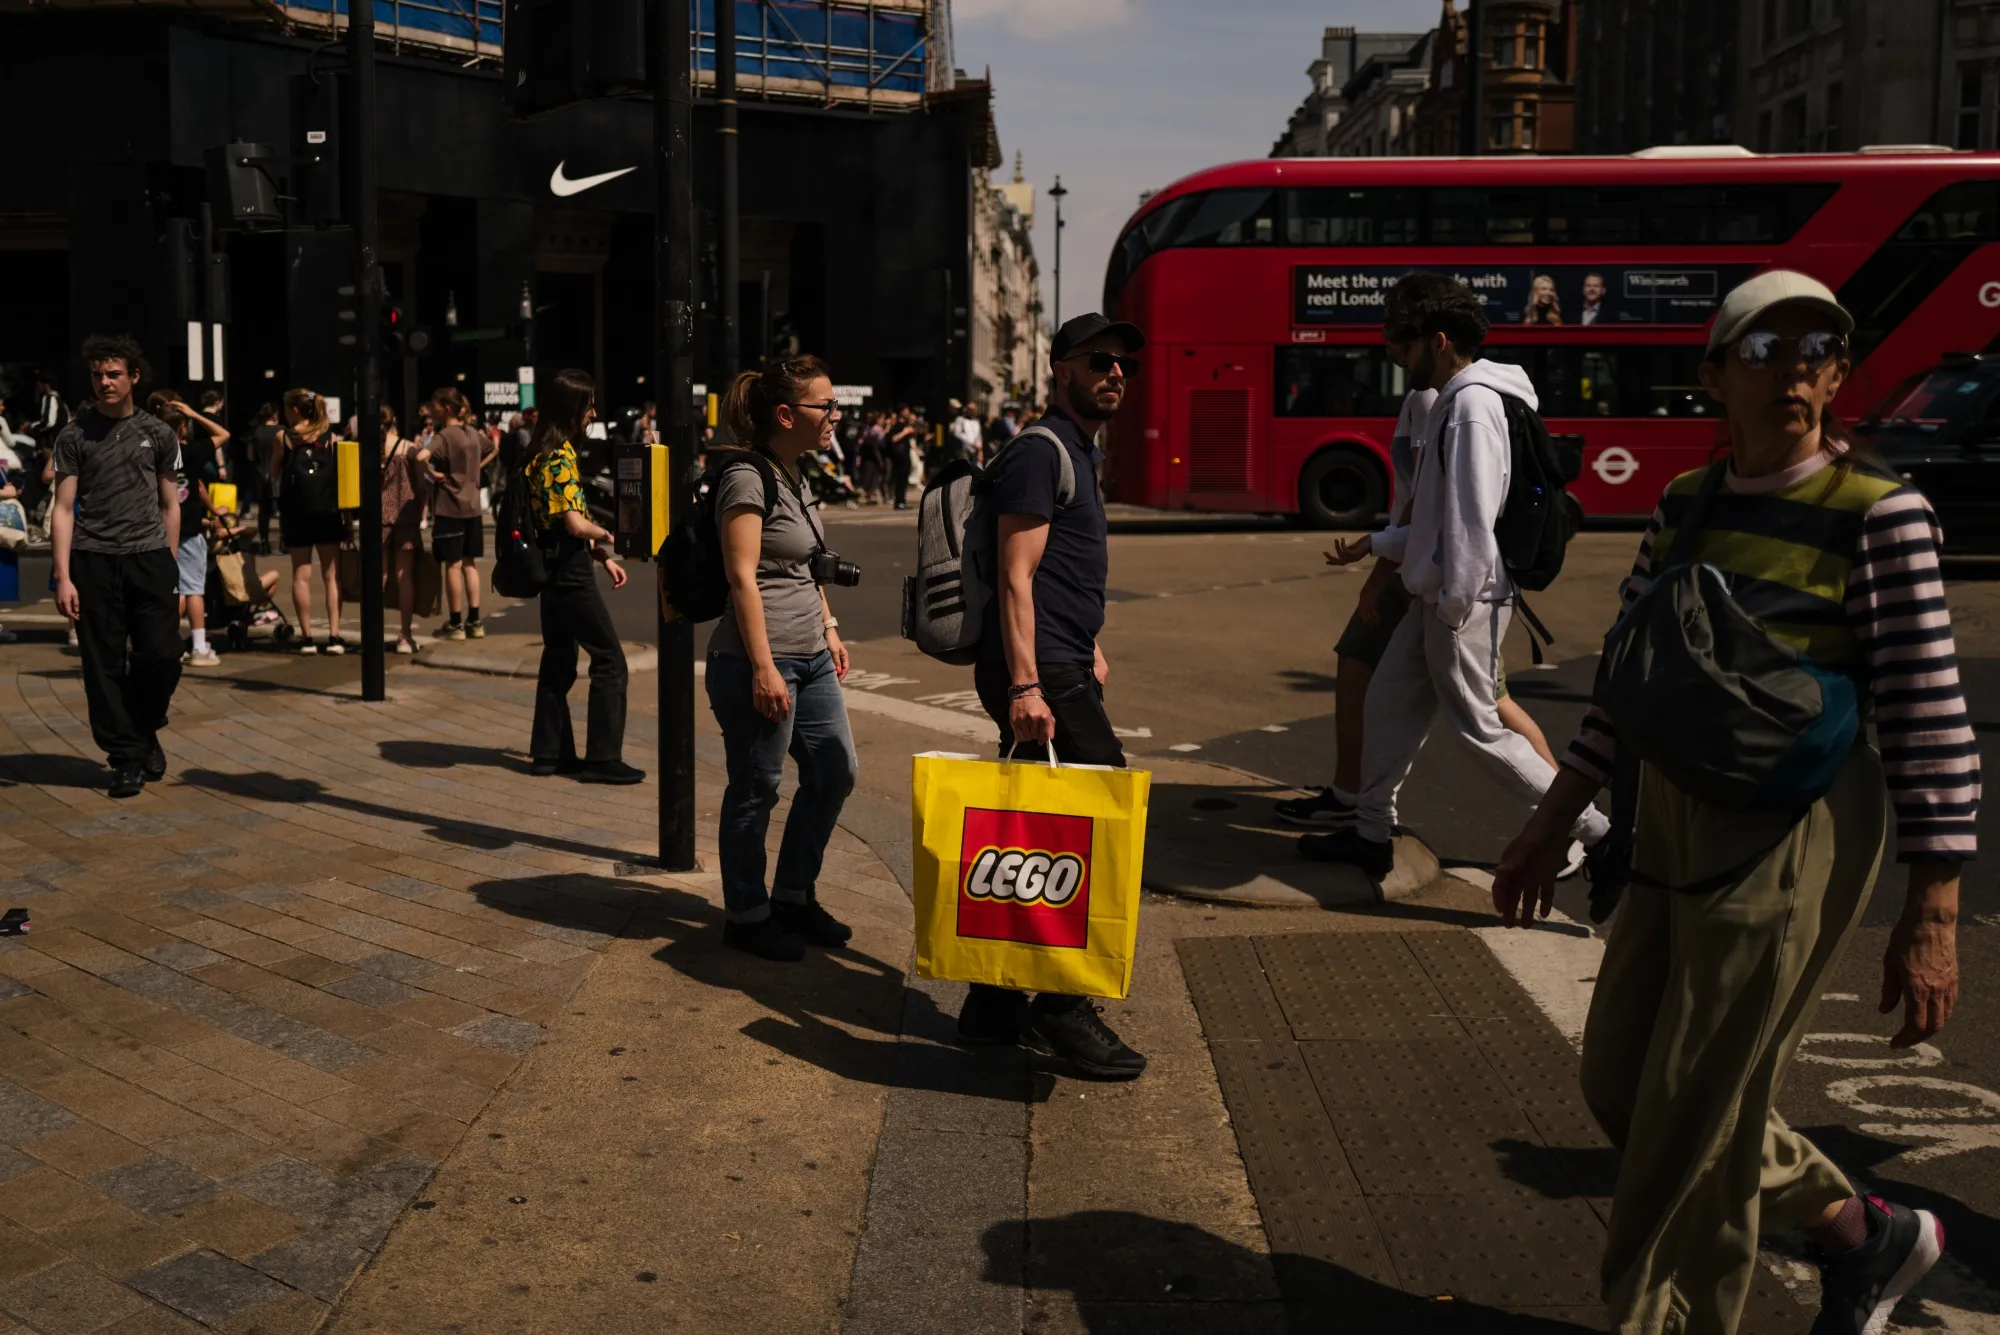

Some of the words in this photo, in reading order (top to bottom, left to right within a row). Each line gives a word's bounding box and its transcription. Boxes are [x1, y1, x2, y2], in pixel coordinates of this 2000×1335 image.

[1307, 273, 1349, 288] Meet
[1352, 273, 1379, 288] the
[1382, 276, 1399, 288] re
[1472, 272, 1508, 288] with
[1307, 290, 1337, 306] real
[620, 482, 641, 497] WAIT
[968, 849, 1081, 904] LEGO
